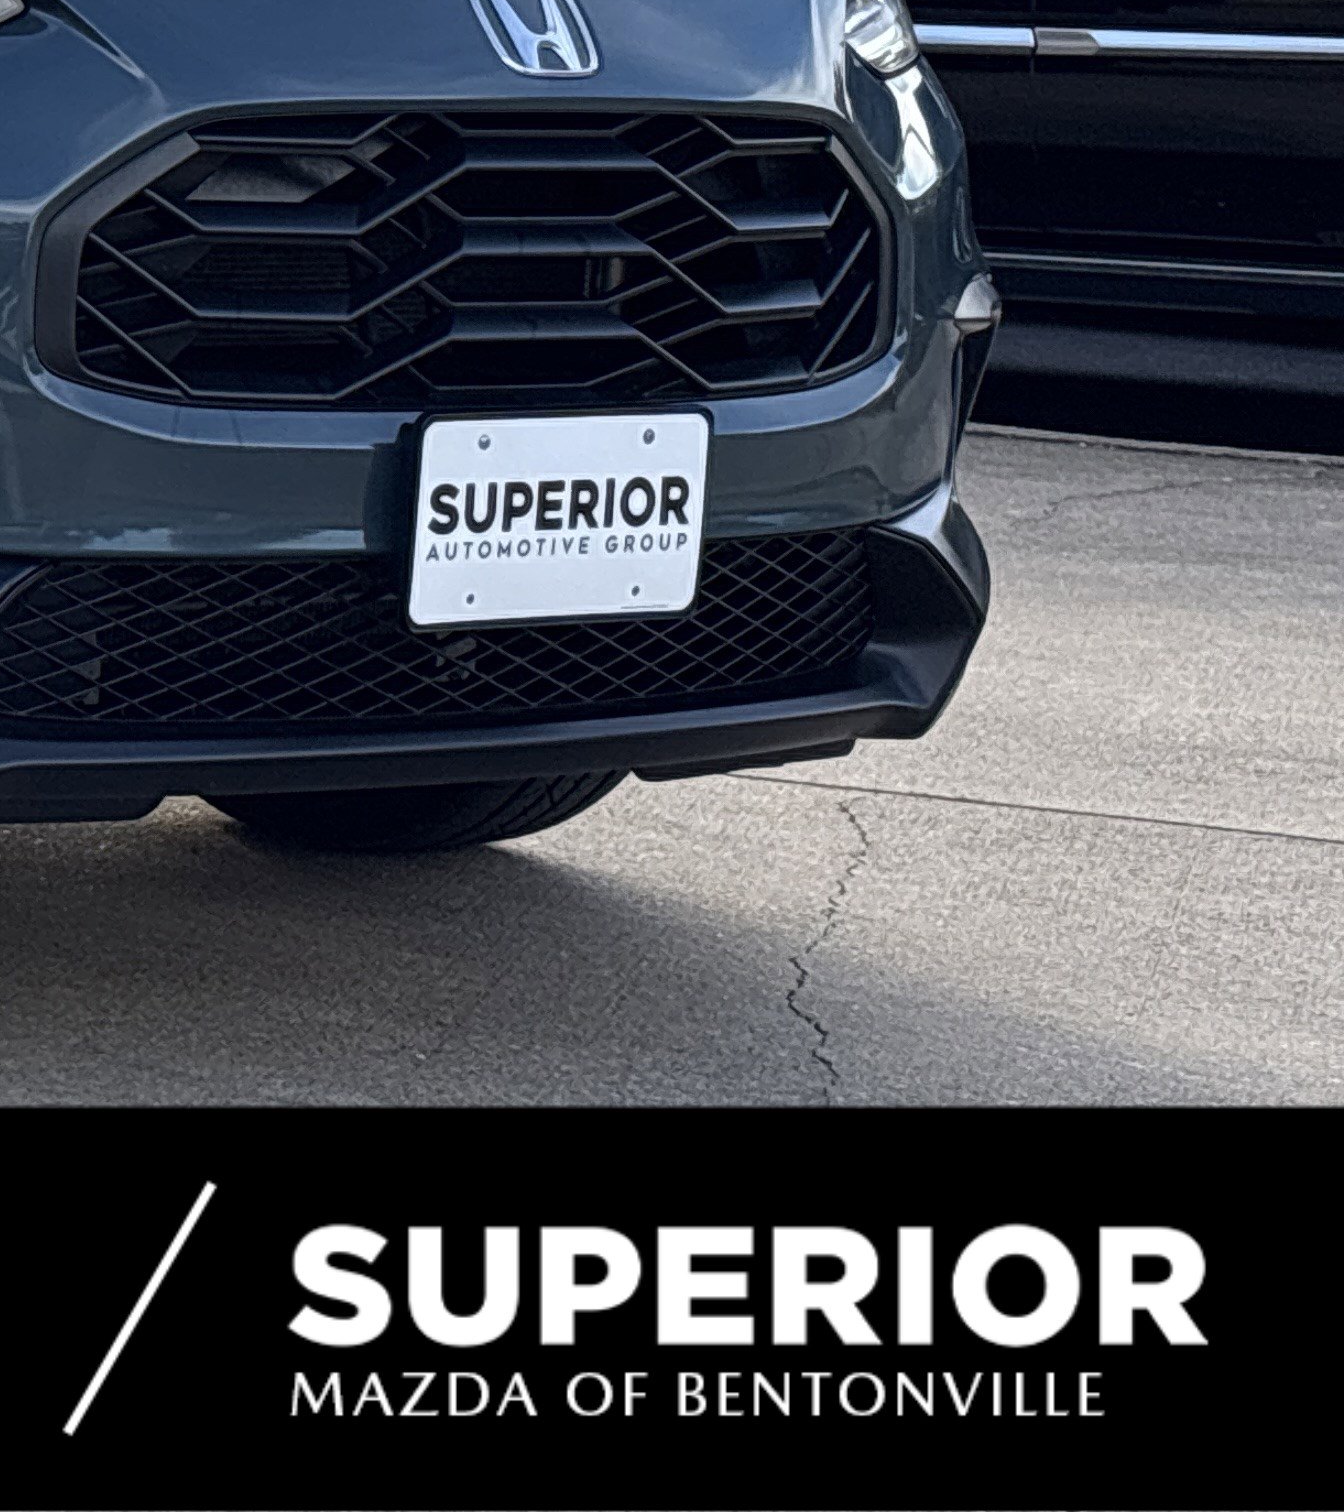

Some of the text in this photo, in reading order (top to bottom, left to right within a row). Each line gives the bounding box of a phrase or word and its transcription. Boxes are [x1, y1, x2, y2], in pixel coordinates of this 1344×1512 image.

[427, 476, 690, 535] SUPERIOR
[425, 532, 688, 562] AUTOMOTIVE GROUP
